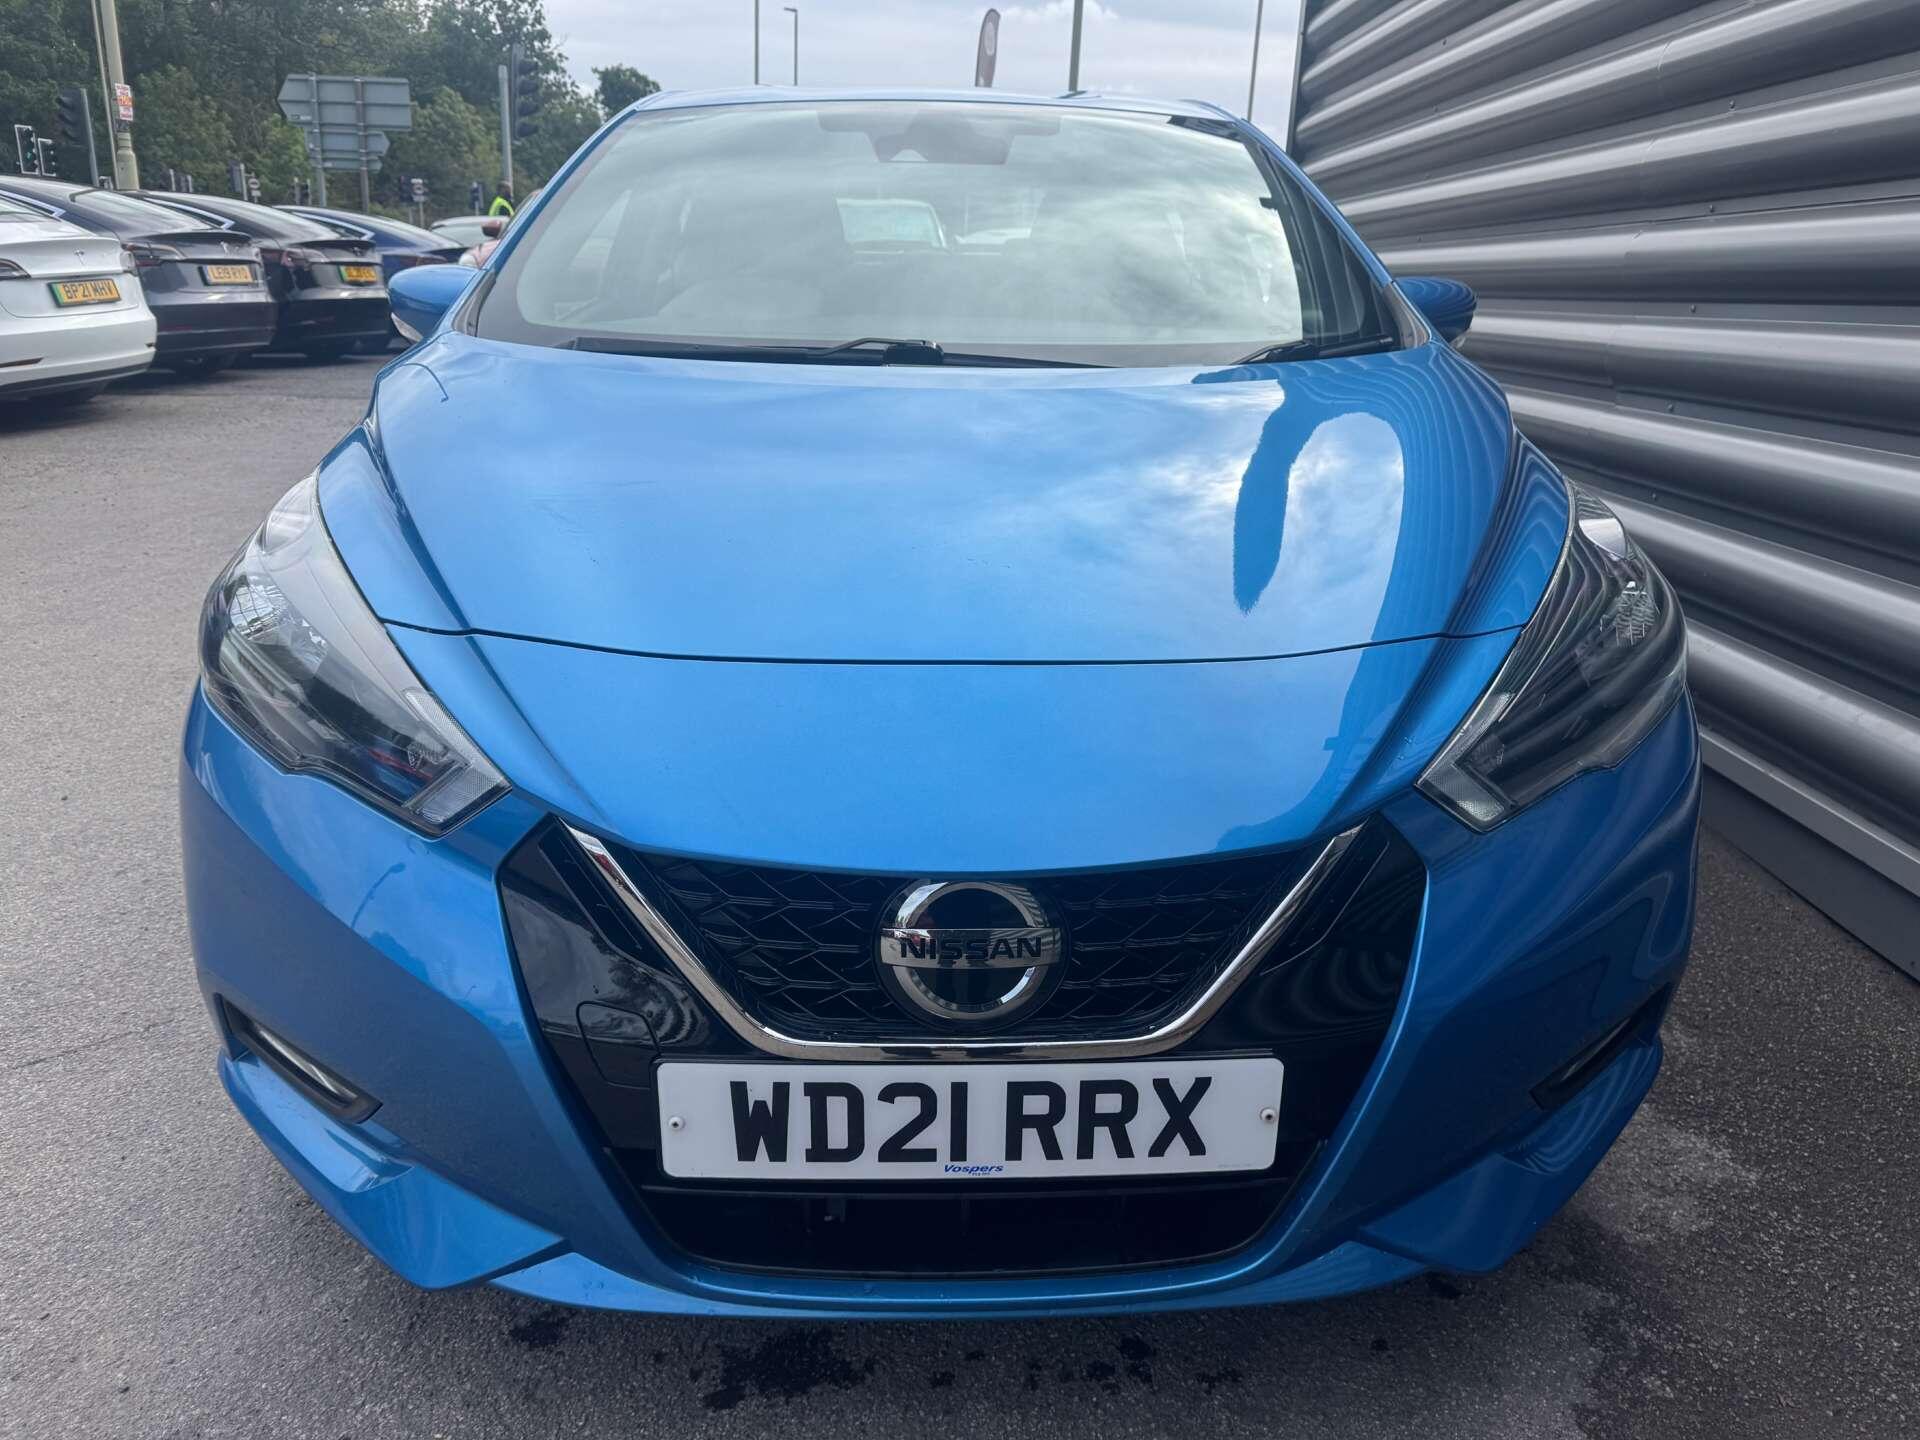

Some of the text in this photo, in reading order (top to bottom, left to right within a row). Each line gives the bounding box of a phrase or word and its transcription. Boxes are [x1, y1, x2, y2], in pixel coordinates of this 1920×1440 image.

[63, 282, 92, 299] BP21
[900, 936, 1042, 960] NISSAN
[730, 1075, 1213, 1164] WD21 RRX
[944, 1164, 1004, 1174] Vospers
